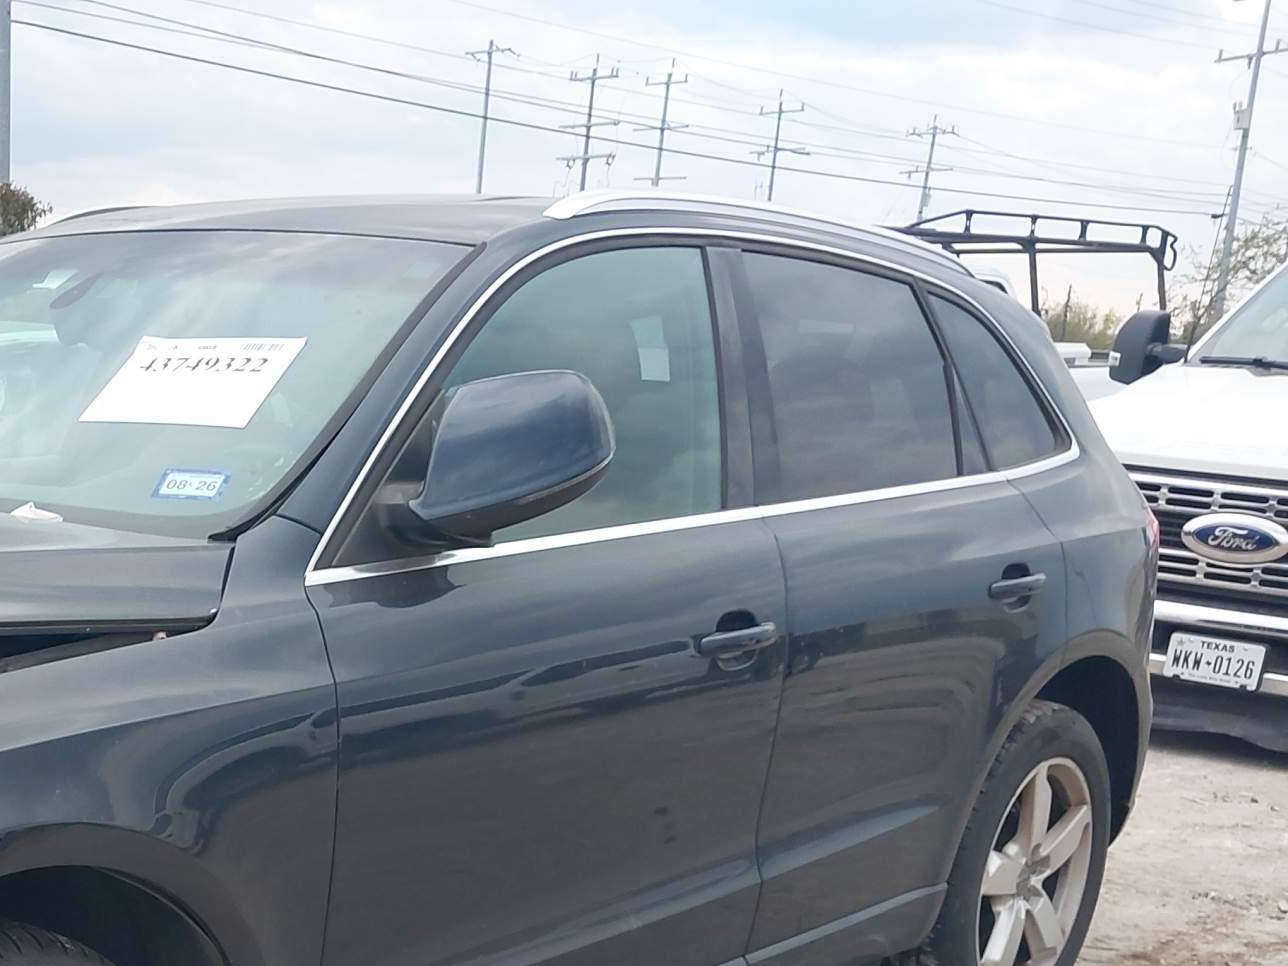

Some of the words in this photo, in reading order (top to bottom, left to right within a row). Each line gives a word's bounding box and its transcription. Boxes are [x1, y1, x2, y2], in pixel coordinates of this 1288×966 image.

[140, 357, 269, 373] 43749322
[1208, 526, 1258, 550] Ford
[1200, 640, 1235, 653] TEXAS
